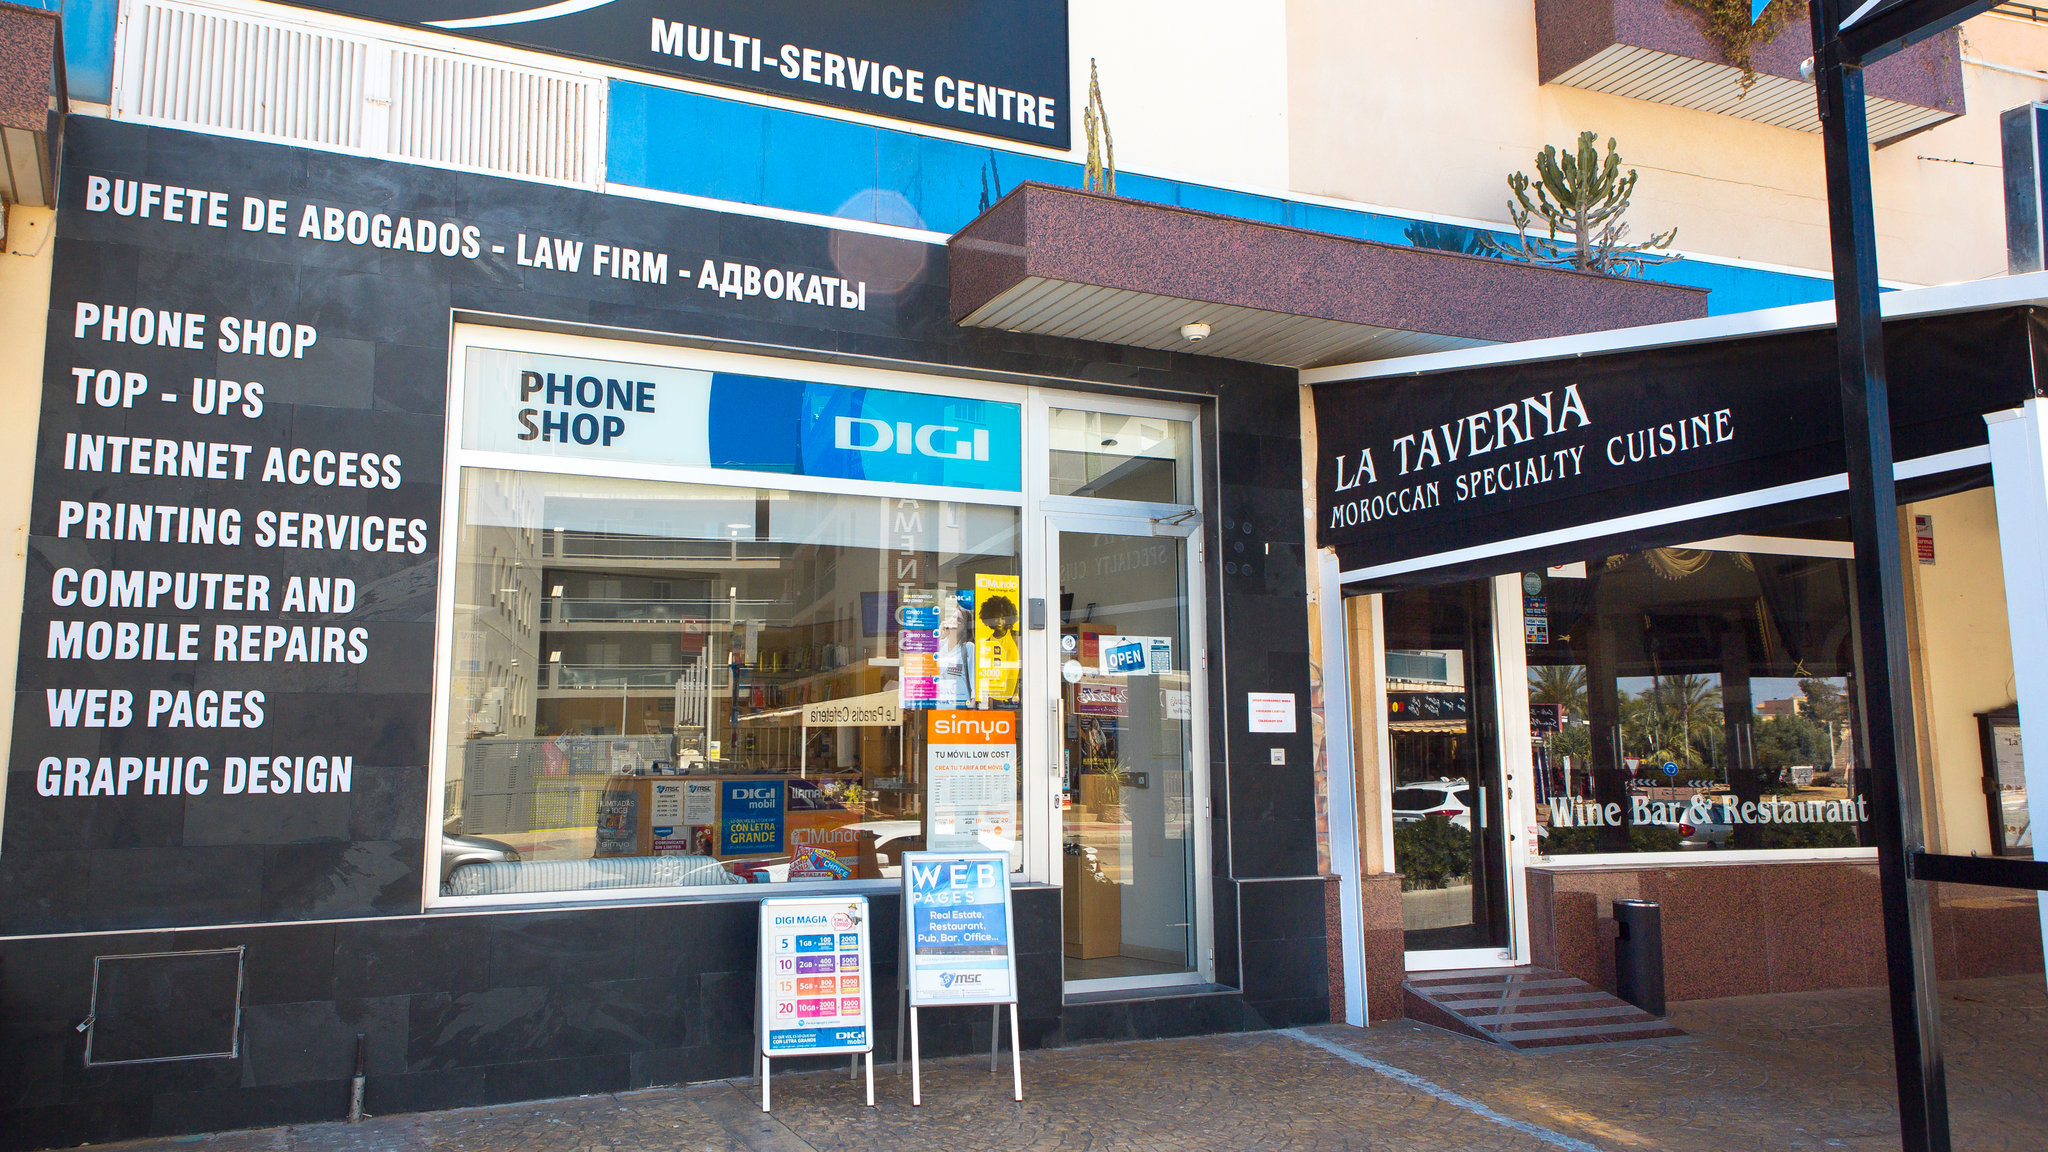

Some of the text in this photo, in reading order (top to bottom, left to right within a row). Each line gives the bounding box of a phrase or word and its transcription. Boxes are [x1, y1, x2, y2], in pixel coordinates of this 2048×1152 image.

[652, 18, 1055, 130] MULTI-SERVICE CENTRE
[87, 175, 229, 228] BUFETE
[242, 196, 287, 235] DE
[298, 204, 481, 259] ABOGADOS
[516, 232, 583, 273] LAW
[593, 243, 668, 285] FIRM
[697, 259, 866, 311] АДВОКАТЫ
[74, 301, 317, 359] PHONE SHOP
[72, 367, 148, 408] TOP
[192, 377, 265, 419] UPS
[520, 370, 656, 413] PHONE
[517, 408, 626, 447] SHOP
[835, 415, 990, 462] DIGI
[1334, 383, 1592, 492] LA TAVERNA
[64, 432, 402, 490] INTERNET ACCESS
[1330, 408, 1735, 529] MOROCCAN SPECIALTY CUISINE
[58, 500, 428, 555] PRINTING SERVICES
[52, 567, 356, 614] COMPUTER AND
[987, 578, 1017, 589] Mundo
[47, 620, 369, 664] MOBILE REPAIRS
[1109, 649, 1142, 667] OPEN
[47, 688, 266, 729] WEB PAGES
[935, 714, 1010, 741] simyo
[947, 750, 971, 759] MÓVIL
[37, 755, 353, 797] GRAPHIC DESIGN
[732, 788, 776, 799] DIGI
[749, 799, 776, 809] mobil
[1548, 793, 1869, 827] Wine Bar & Restaurant
[730, 832, 775, 843] GRANDE
[731, 823, 775, 832] CON LETRA
[912, 864, 996, 889] WEB
[913, 890, 976, 904] PAGES
[775, 916, 795, 925] DIGI
[797, 915, 828, 924] MAGIA
[930, 911, 951, 920] Real
[781, 938, 789, 949] 5
[918, 933, 939, 943] Pub,
[940, 933, 960, 942] Bar,
[779, 959, 792, 970] 10
[779, 981, 793, 991] 15
[778, 1002, 793, 1014] 20
[836, 1031, 865, 1040] DIGI
